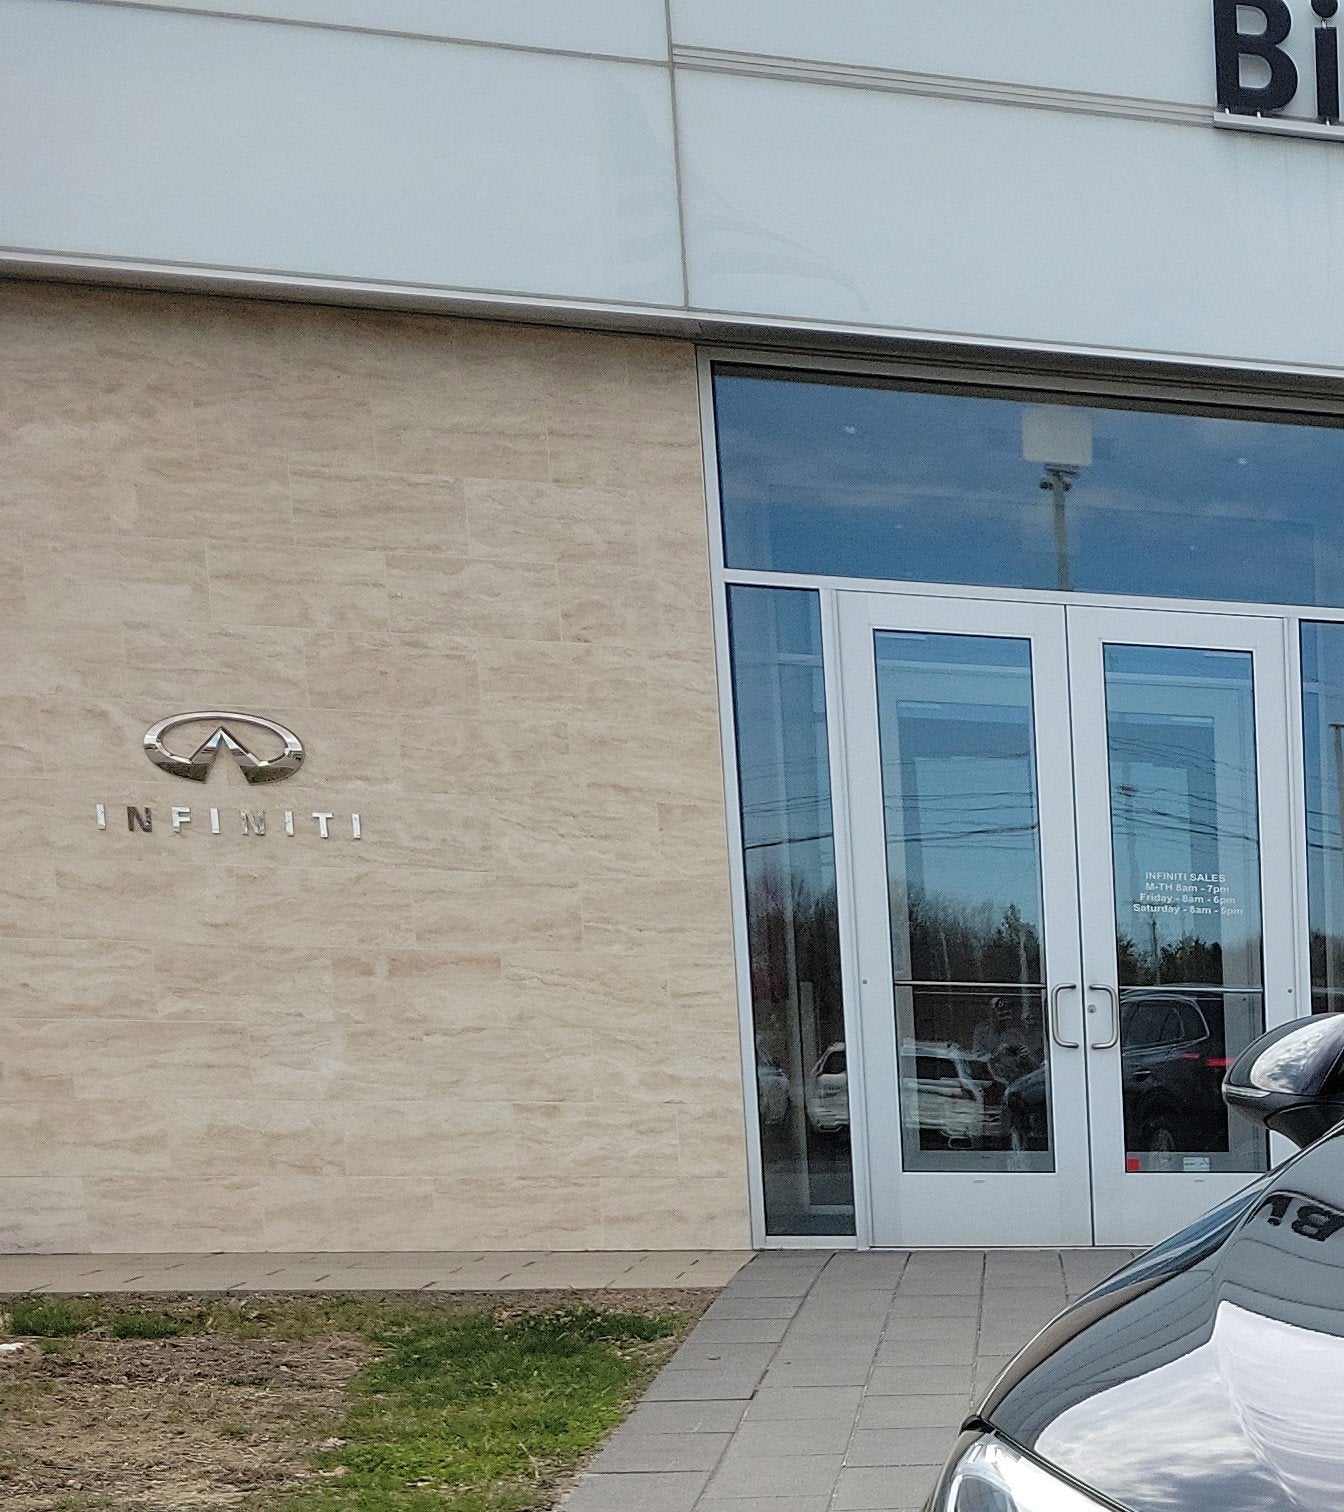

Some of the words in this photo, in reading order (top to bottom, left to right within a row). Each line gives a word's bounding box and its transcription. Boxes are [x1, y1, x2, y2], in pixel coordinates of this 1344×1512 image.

[95, 803, 363, 840] INFINITI
[1145, 871, 1187, 881] INFINITI
[1190, 872, 1227, 883] SALES
[1139, 892, 1173, 904] Friday
[1133, 903, 1180, 915] Saturday
